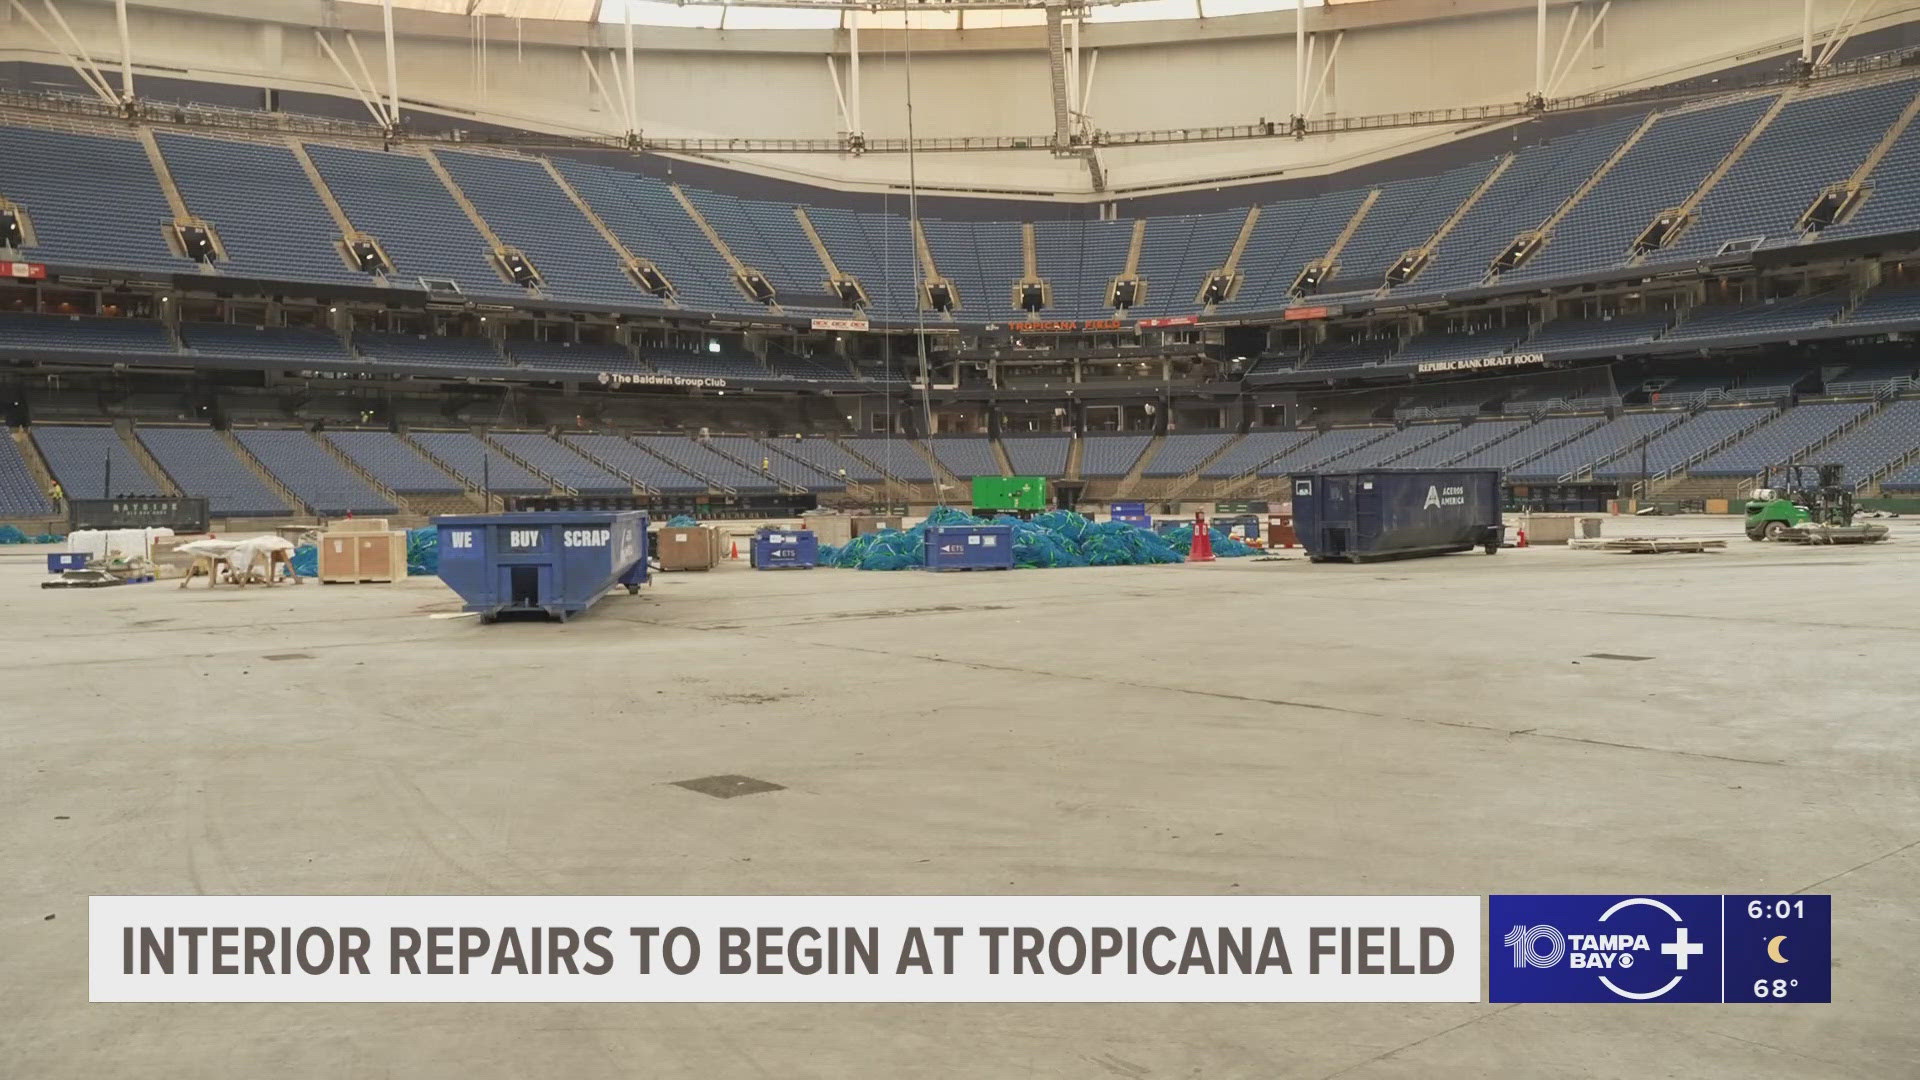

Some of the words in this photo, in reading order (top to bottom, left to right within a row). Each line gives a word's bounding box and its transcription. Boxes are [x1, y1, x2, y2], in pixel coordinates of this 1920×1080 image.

[1008, 320, 1077, 330] TROPICANA
[1085, 319, 1122, 329] FIELD
[1418, 361, 1457, 372] REPUBLIC
[1457, 359, 1482, 369] BANK
[1483, 356, 1513, 367] DRAFT
[1514, 353, 1544, 364] ROOM
[611, 374, 630, 384] The
[632, 374, 672, 385] Baldwin
[673, 376, 703, 387] Group
[704, 378, 725, 387] Club
[1441, 496, 1464, 506] AMERICA
[452, 531, 473, 548] WE
[510, 530, 539, 548] BUY
[563, 529, 610, 548] SCRAP
